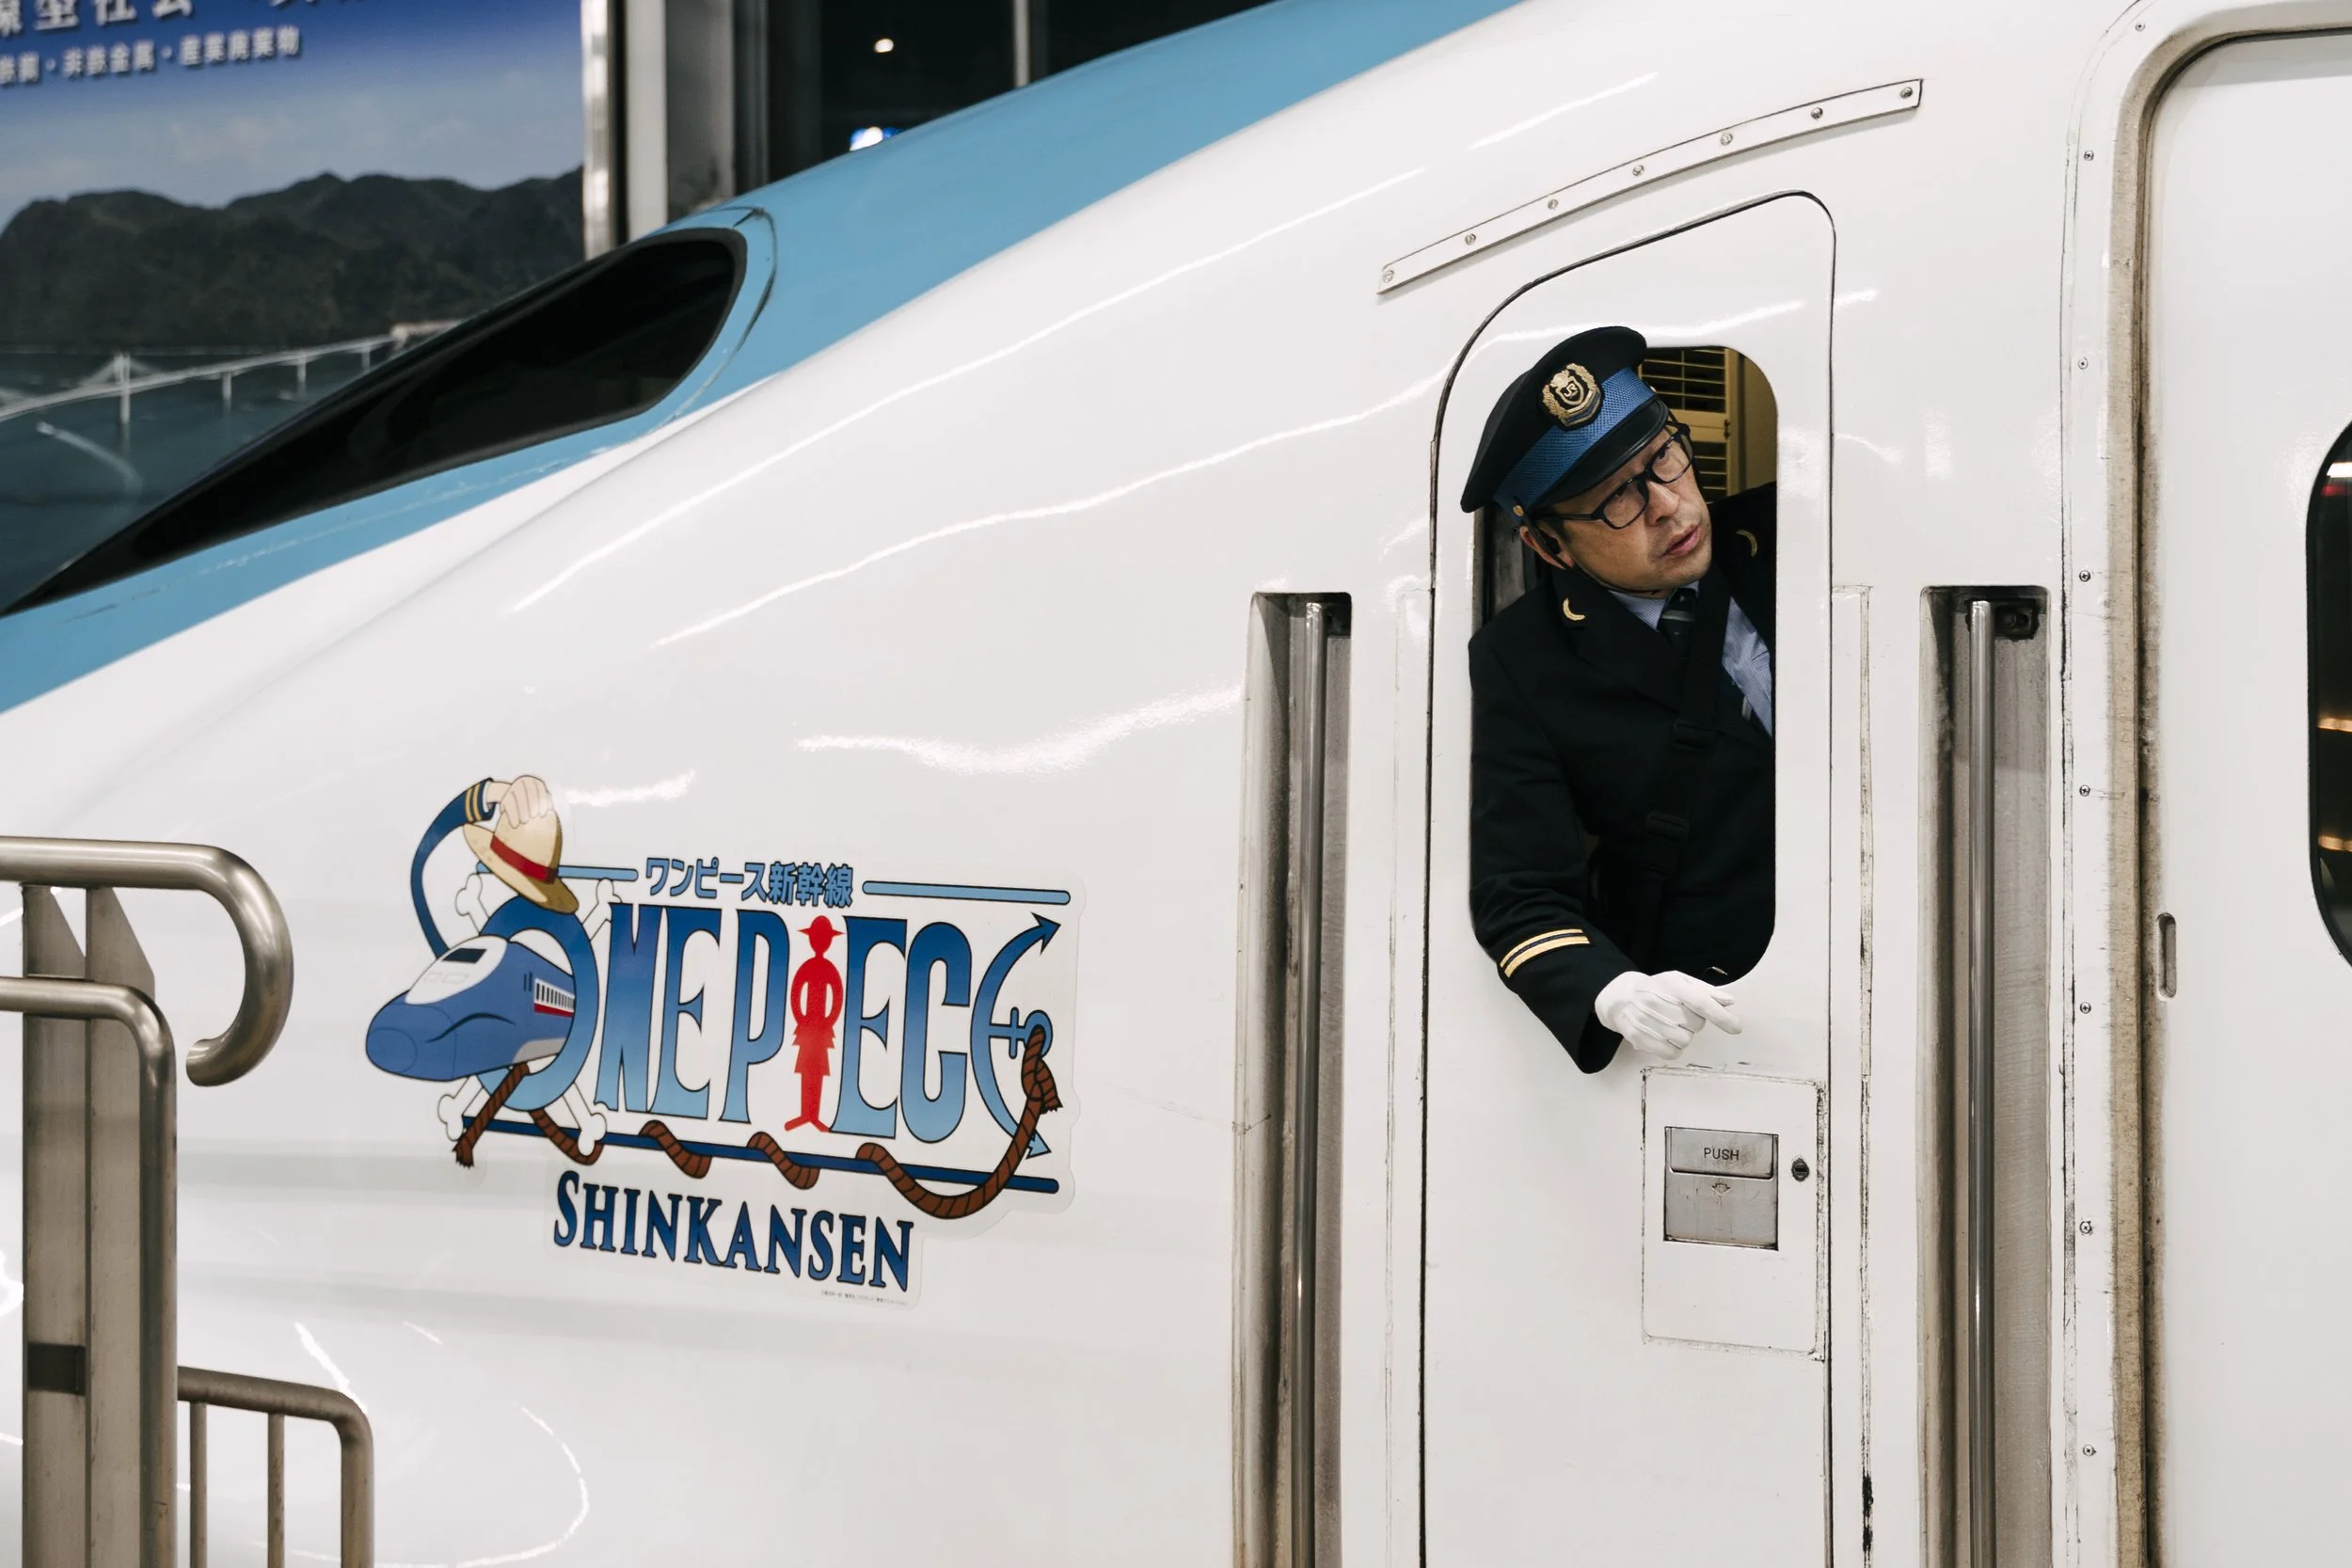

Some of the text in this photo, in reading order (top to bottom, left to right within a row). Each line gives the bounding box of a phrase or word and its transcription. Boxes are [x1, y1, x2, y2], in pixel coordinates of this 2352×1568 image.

[645, 857, 853, 908] ワンピース新幹線
[1704, 1148, 1740, 1161] PUSH
[553, 1171, 914, 1292] SHINKANSEN
